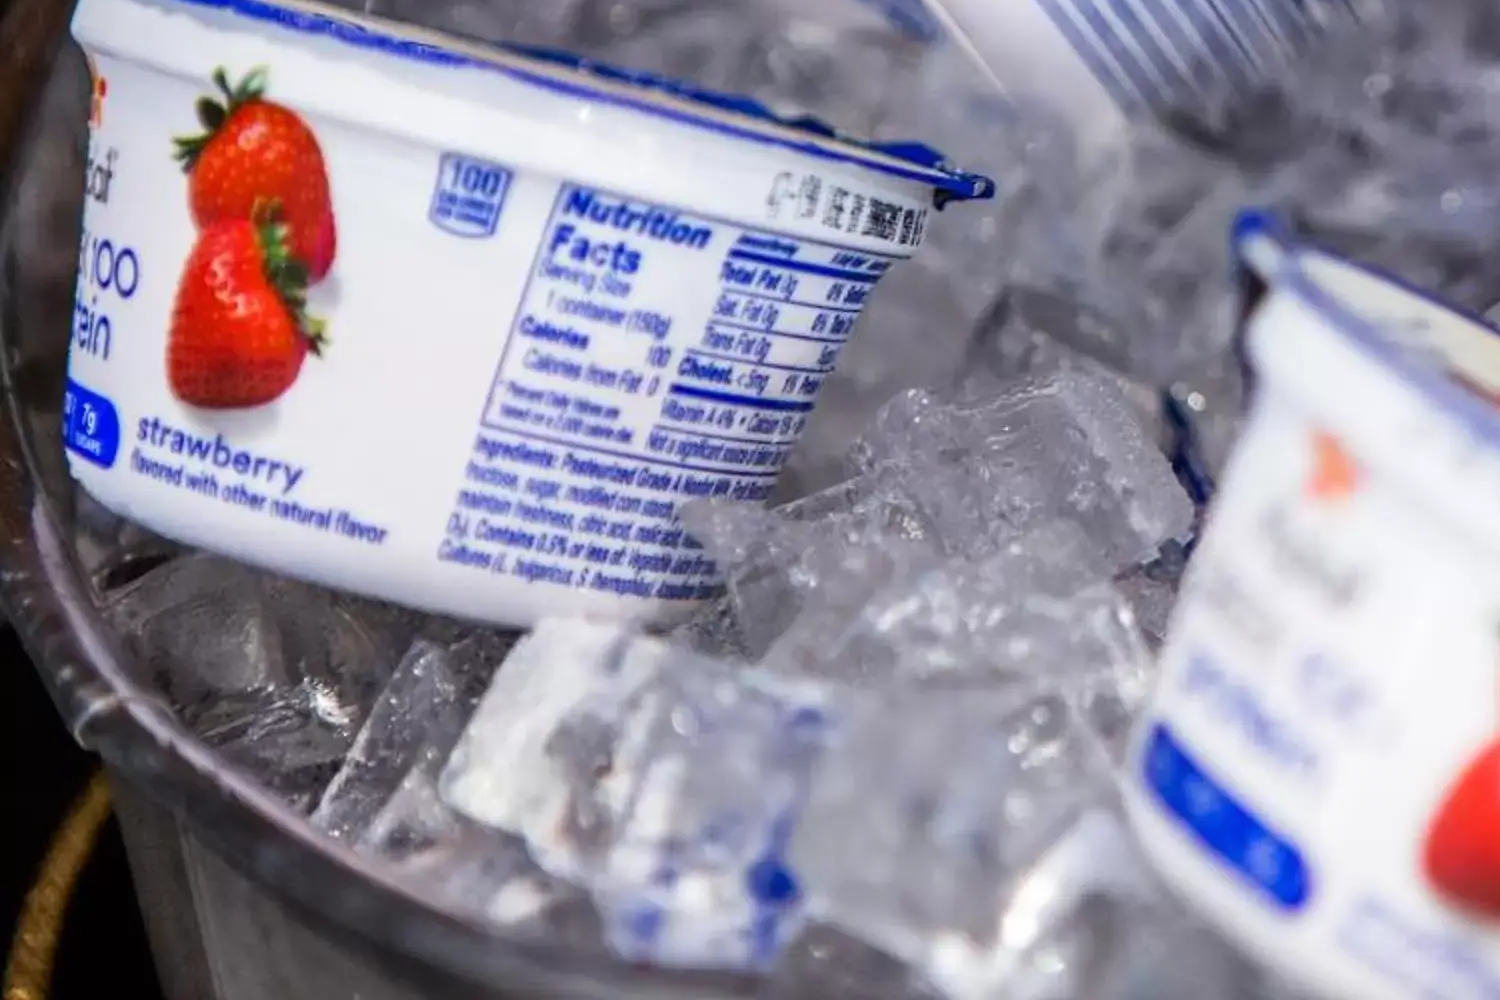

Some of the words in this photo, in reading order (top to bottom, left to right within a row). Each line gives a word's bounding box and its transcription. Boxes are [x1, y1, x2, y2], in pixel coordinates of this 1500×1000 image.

[452, 160, 501, 198] 100
[551, 223, 642, 274] Facts
[565, 189, 712, 250] Nutrition
[91, 238, 138, 299] 100
[519, 315, 590, 350] Calories
[136, 416, 304, 494] strawberry
[131, 446, 183, 487] flavored
[185, 471, 218, 498] with
[221, 483, 267, 512] other
[269, 499, 332, 530] natural
[335, 511, 388, 545] flavor
